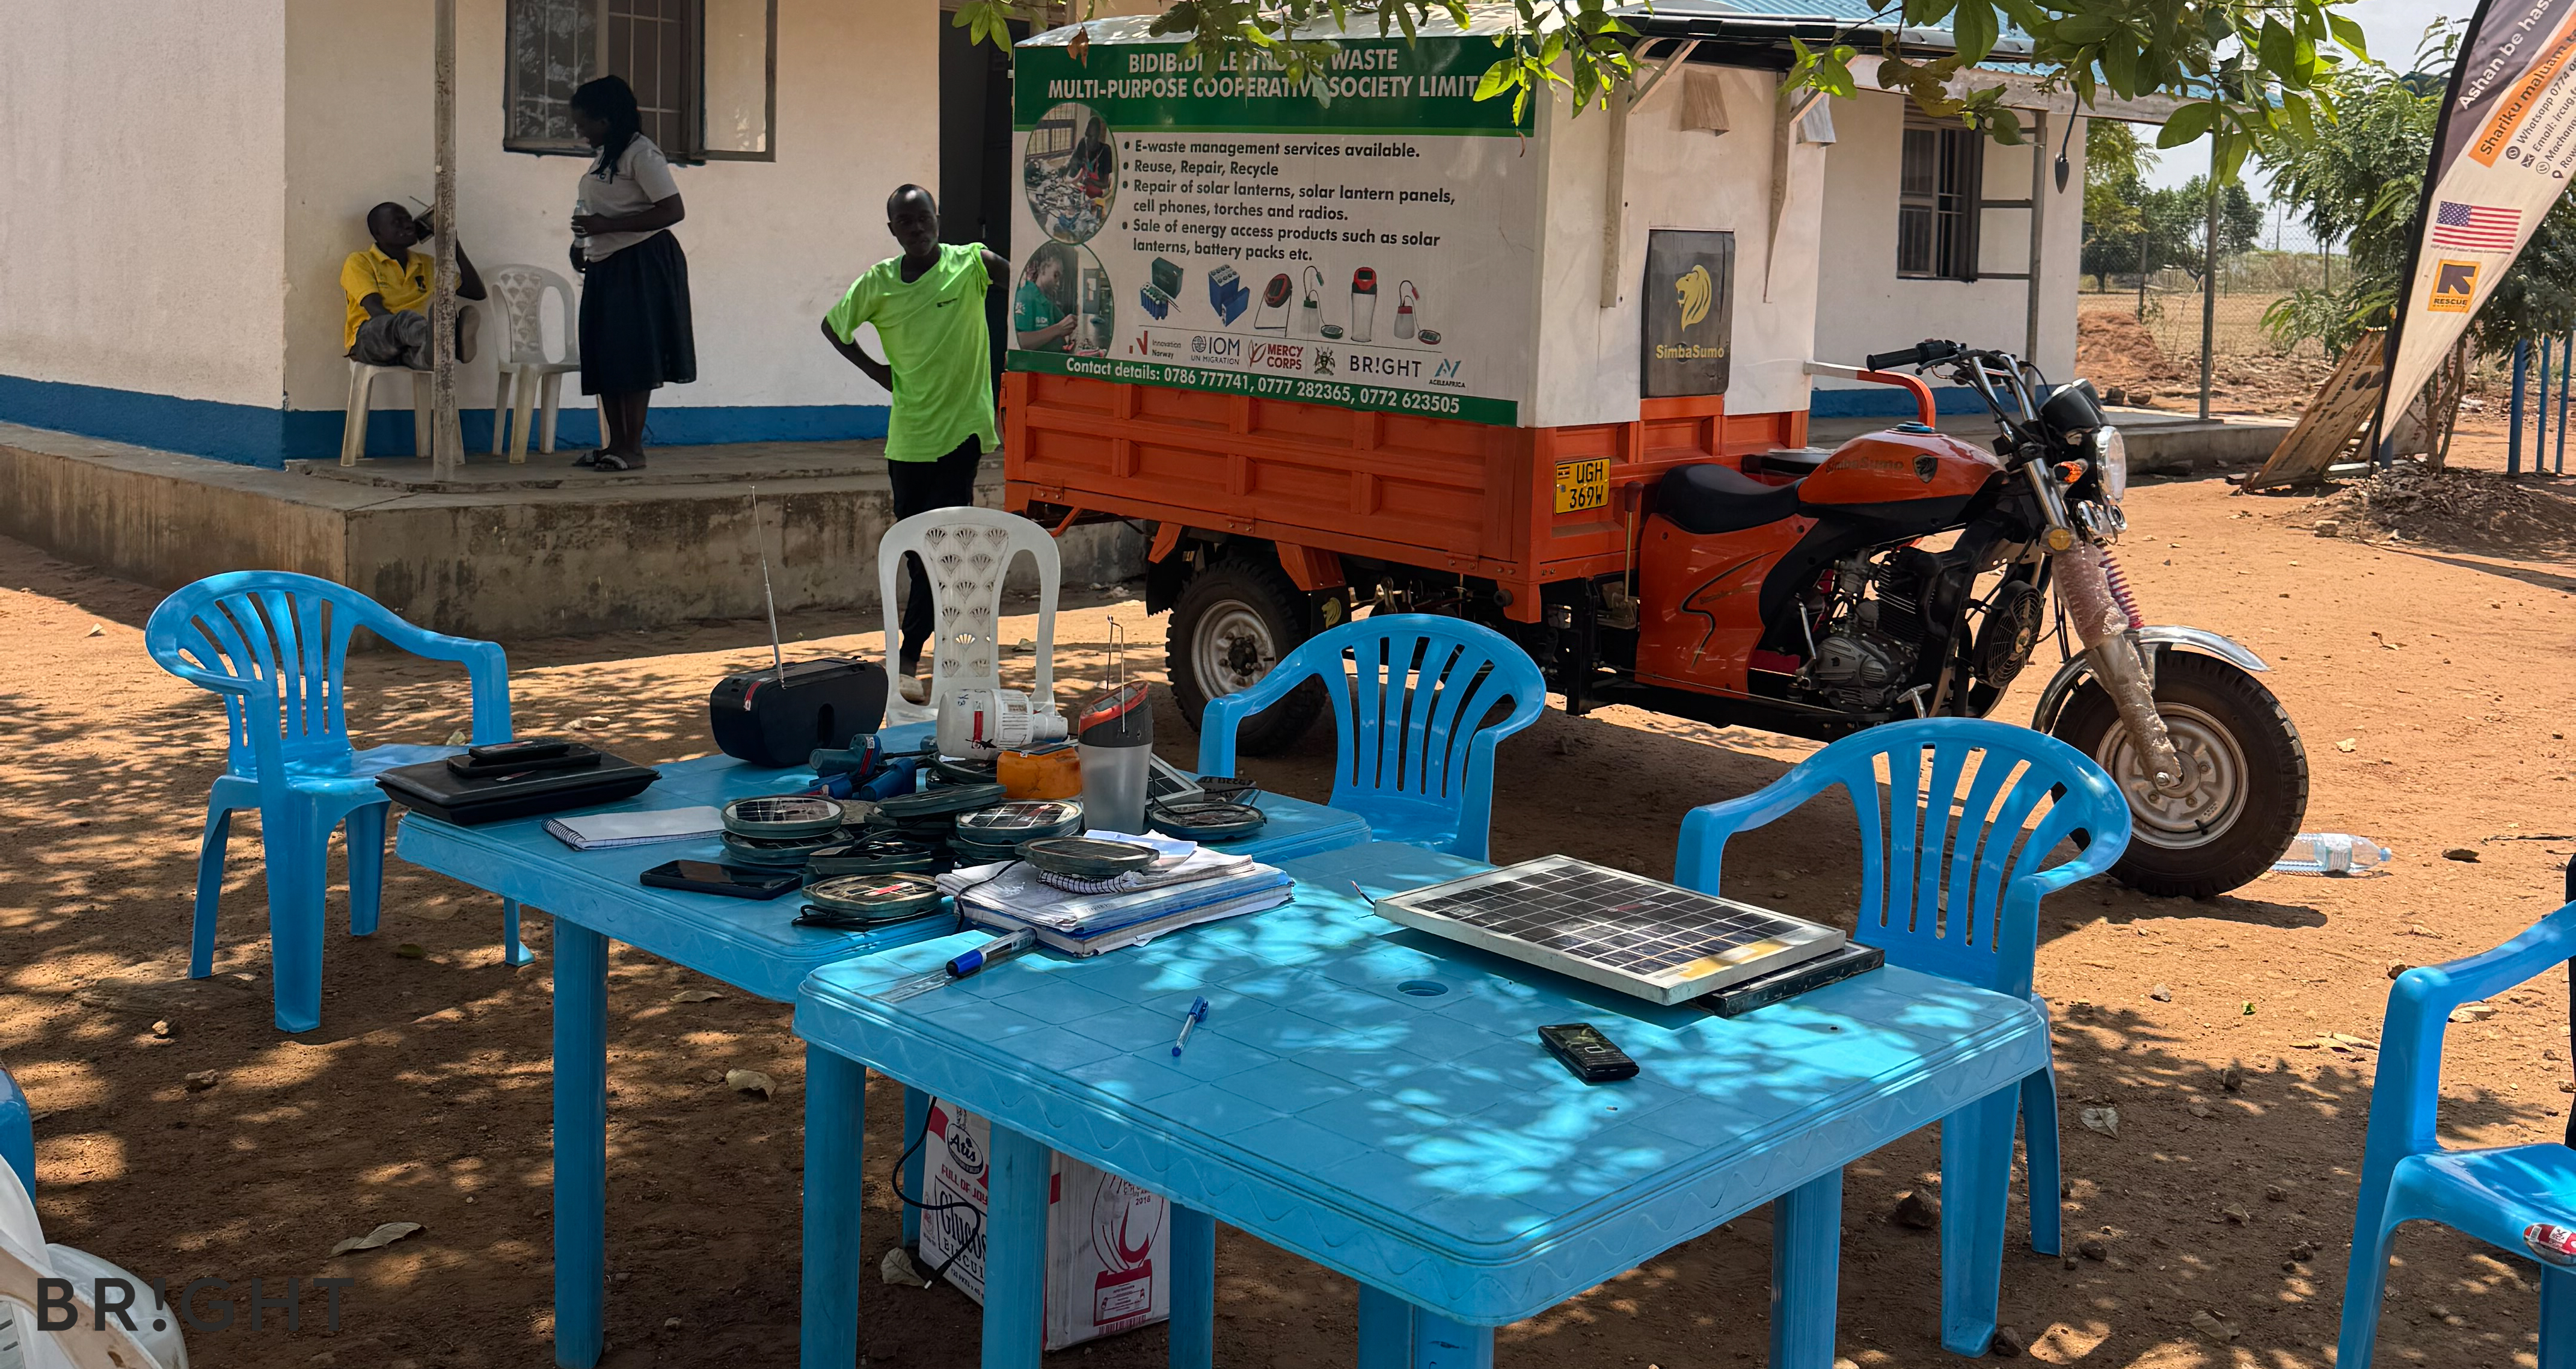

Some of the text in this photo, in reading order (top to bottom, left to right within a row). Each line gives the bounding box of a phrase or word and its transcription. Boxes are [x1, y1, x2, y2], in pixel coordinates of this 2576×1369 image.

[1331, 49, 1398, 70] WASTE
[2459, 0, 2554, 109] Ashan be has
[1048, 75, 1504, 99] MULTI-PURPOSE COOPERATV SOCIETY LIMIT
[2516, 97, 2554, 144] Whatsapp
[2550, 71, 2570, 96] 0774
[2480, 102, 2522, 155] Shariku
[2532, 122, 2557, 152] Email:
[2544, 116, 2576, 161] Machana
[1135, 140, 1420, 158] E-waste management services available.
[1134, 159, 1279, 179] Reuse, Repair, Recycle
[1134, 179, 1455, 206] Repair of solar lanterns, solar lantern panels,
[1133, 198, 1348, 221] cell phones, torches and radios.
[1133, 218, 1441, 247] Sale of energy access products such as solar
[1133, 237, 1312, 261] lanterns, battery packs etc.
[1152, 339, 1182, 349] Innovation
[1209, 336, 1240, 356] IOM
[1267, 343, 1304, 357] MERCY
[1655, 344, 1725, 359] SimbaSumo
[1203, 356, 1240, 365] MIGRATION
[1266, 356, 1302, 370] CORPS
[1350, 355, 1422, 377] BR!GHT
[1066, 357, 1460, 413] Contact details: 0786 777741, 0777 282365, 0772 623505
[1577, 461, 1603, 484] UGH
[1569, 485, 1604, 509] 369W
[941, 1163, 959, 1187] FULL
[960, 1179, 971, 1193] OF
